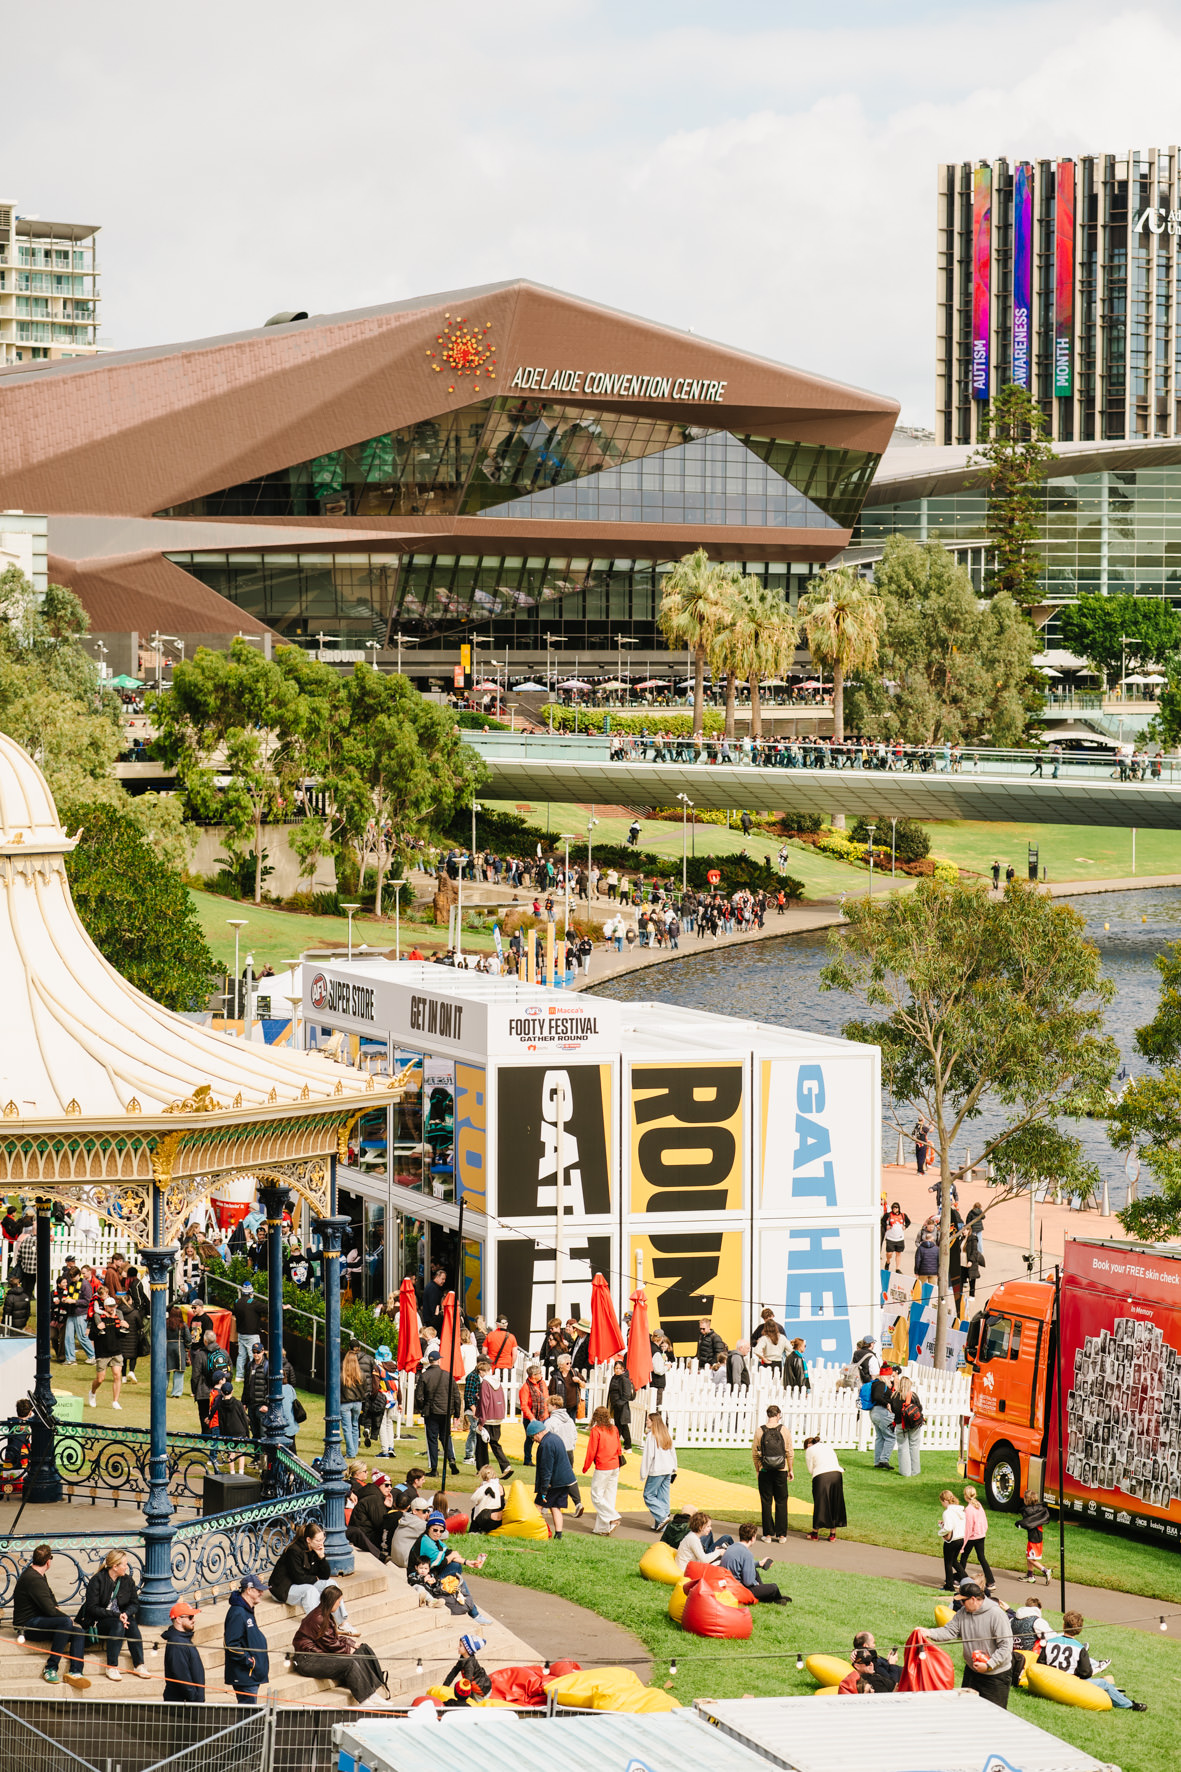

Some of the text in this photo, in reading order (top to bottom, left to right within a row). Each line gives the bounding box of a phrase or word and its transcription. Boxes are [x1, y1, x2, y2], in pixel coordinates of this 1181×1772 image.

[973, 340, 986, 389] AUTISM
[1014, 308, 1027, 389] AWARENESS
[1056, 338, 1070, 386] MONTH
[511, 367, 728, 401] ADELAIDE CONVENTION CENTRE
[312, 980, 327, 1003] AFL
[328, 979, 375, 1021] SUPER STORE
[410, 995, 463, 1041] GET IN ON IT
[509, 1017, 599, 1036] FOOTY FESTIVAL
[1092, 1258, 1180, 1284] Book your FREE skin check
[1136, 1306, 1154, 1318] Memory
[1050, 1644, 1073, 1672] 23
